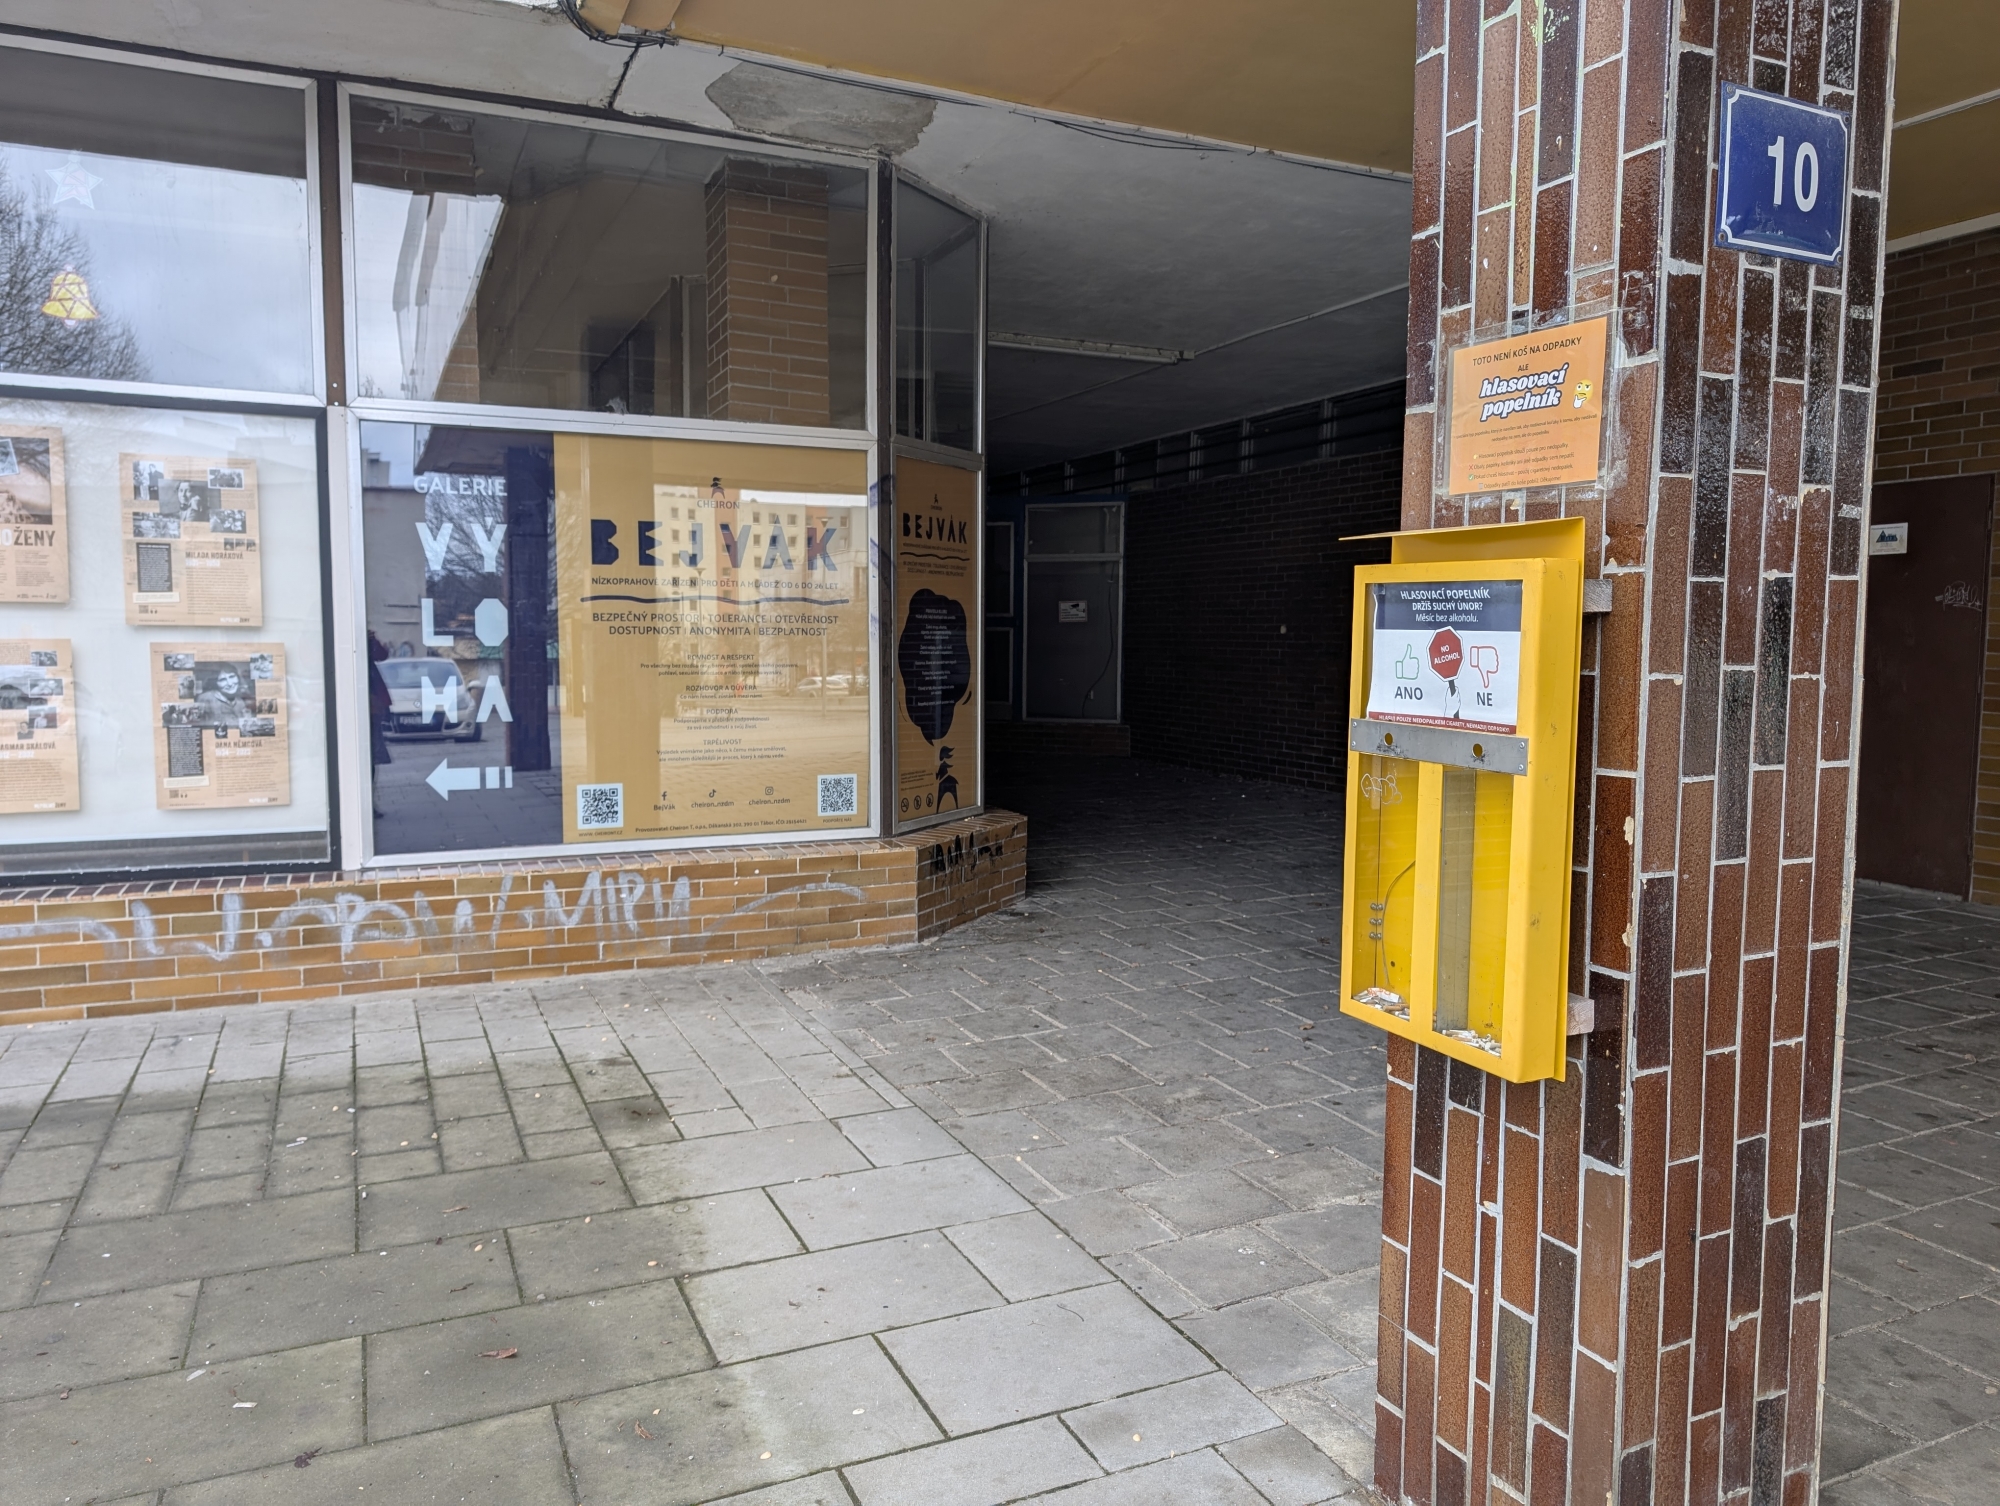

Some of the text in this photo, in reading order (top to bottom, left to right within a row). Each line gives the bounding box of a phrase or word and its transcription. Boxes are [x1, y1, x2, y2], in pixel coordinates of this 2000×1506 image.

[1767, 135, 1819, 212] 10
[1473, 336, 1582, 366] TOTO NENÍ KOŠ NA ODPADKY
[1517, 363, 1529, 372] ALE
[1479, 362, 1570, 398] hlasovací
[1480, 386, 1562, 422] popelník
[413, 476, 508, 496] GALERIE
[696, 499, 741, 510] CHEIRON
[903, 512, 967, 545] BEJVÁK
[590, 514, 839, 571] BEJVÁK
[591, 575, 839, 590] NÍZKOPRAHOVÉ ZAŘÍZENÍ PRO DĚTI A MLÁDEŽ OD 6 DO 26 LET
[1400, 586, 1491, 600] HLASOVACÍ POPELNÍK
[1412, 600, 1483, 611] DRŽÍŠ SUCHÝ ÚNOR?
[421, 598, 509, 647] LO
[592, 610, 839, 624] BEZPEČNÝ PROSTOR TOLERANCE OTEVŘENOST
[1415, 612, 1479, 622] Měsíc bez alkoholu.
[609, 625, 828, 637] DOSTUPNOST ANONYMITA BEZPLATNOST
[1440, 645, 1450, 653] NO
[1434, 652, 1460, 664] ALCOHOL
[1394, 686, 1424, 700] ANO
[1476, 691, 1493, 707] NE
[1412, 717, 1446, 726] NEDOPALKEM
[703, 738, 742, 746] TRPĚLIVOST
[653, 803, 676, 811] BejVák
[691, 800, 735, 809] cheiron_nzdm
[748, 797, 791, 806] cheiron_nzdm
